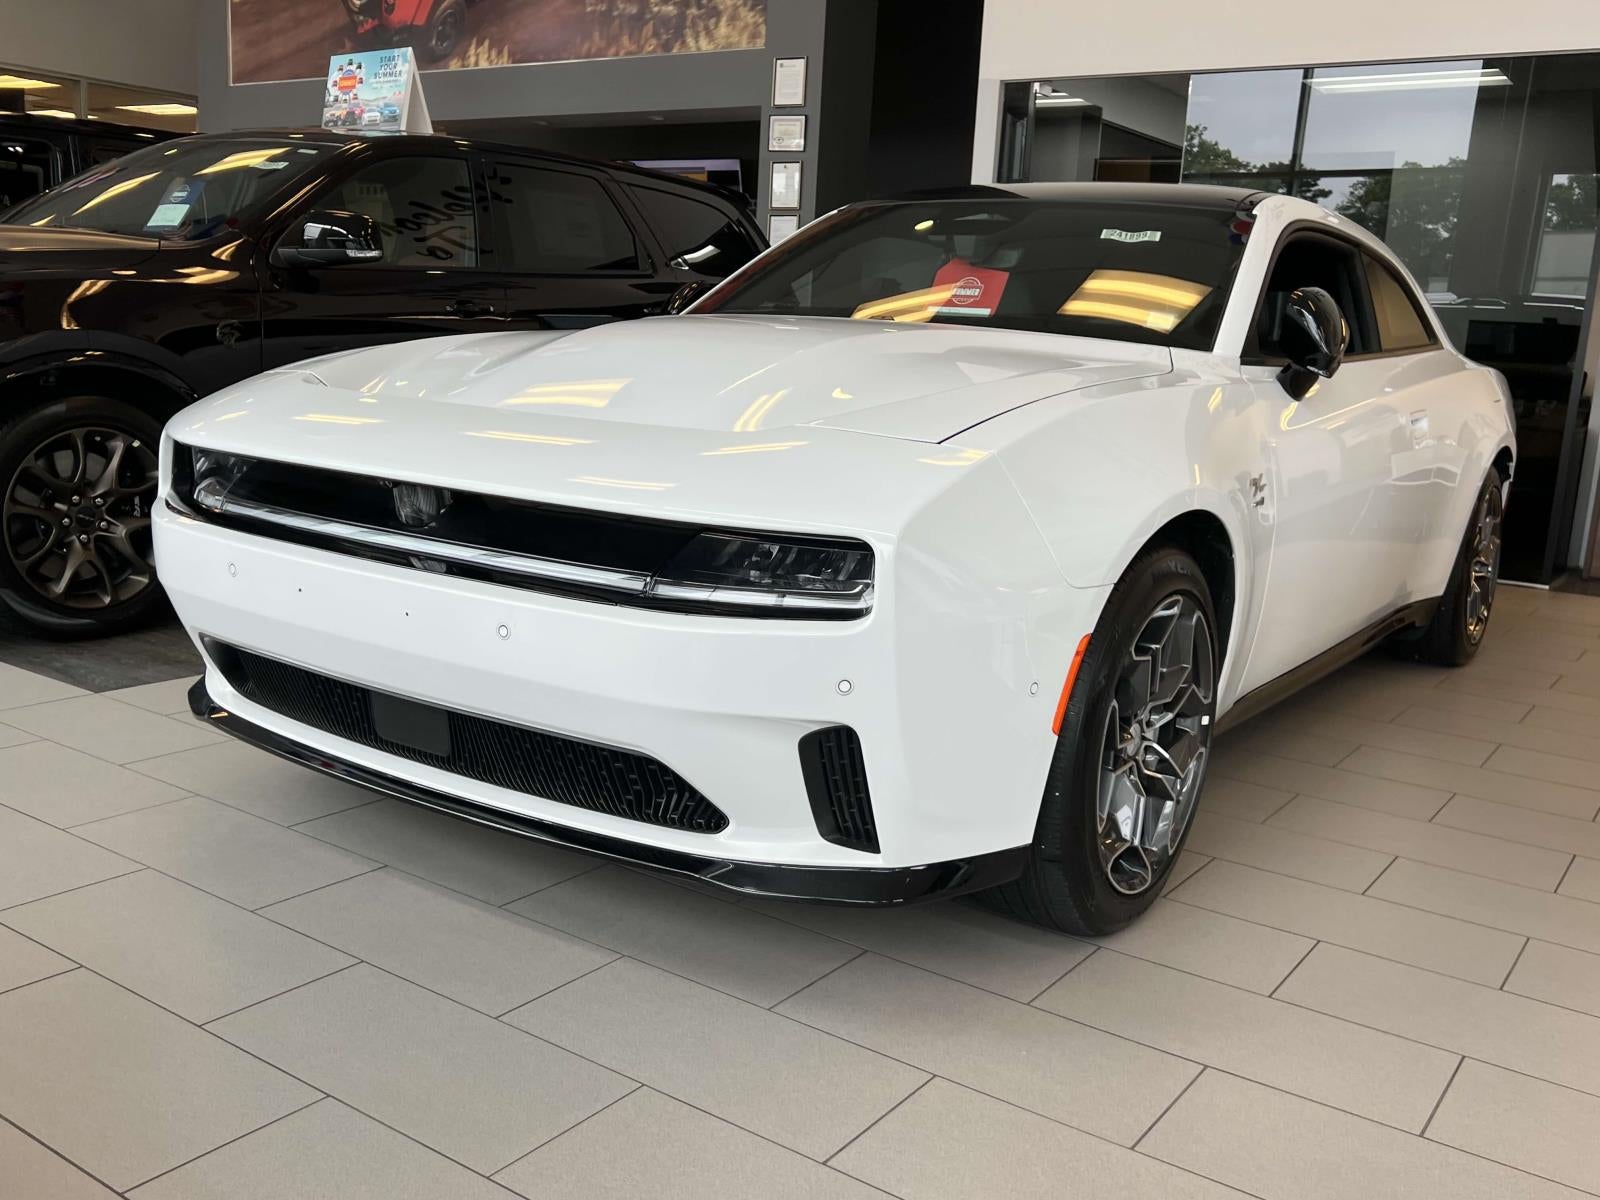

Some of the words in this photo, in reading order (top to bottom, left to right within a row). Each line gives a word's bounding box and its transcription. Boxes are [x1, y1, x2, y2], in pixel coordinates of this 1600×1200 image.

[379, 54, 401, 63] START
[379, 62, 398, 71] YOUR
[373, 69, 402, 79] SUMMER
